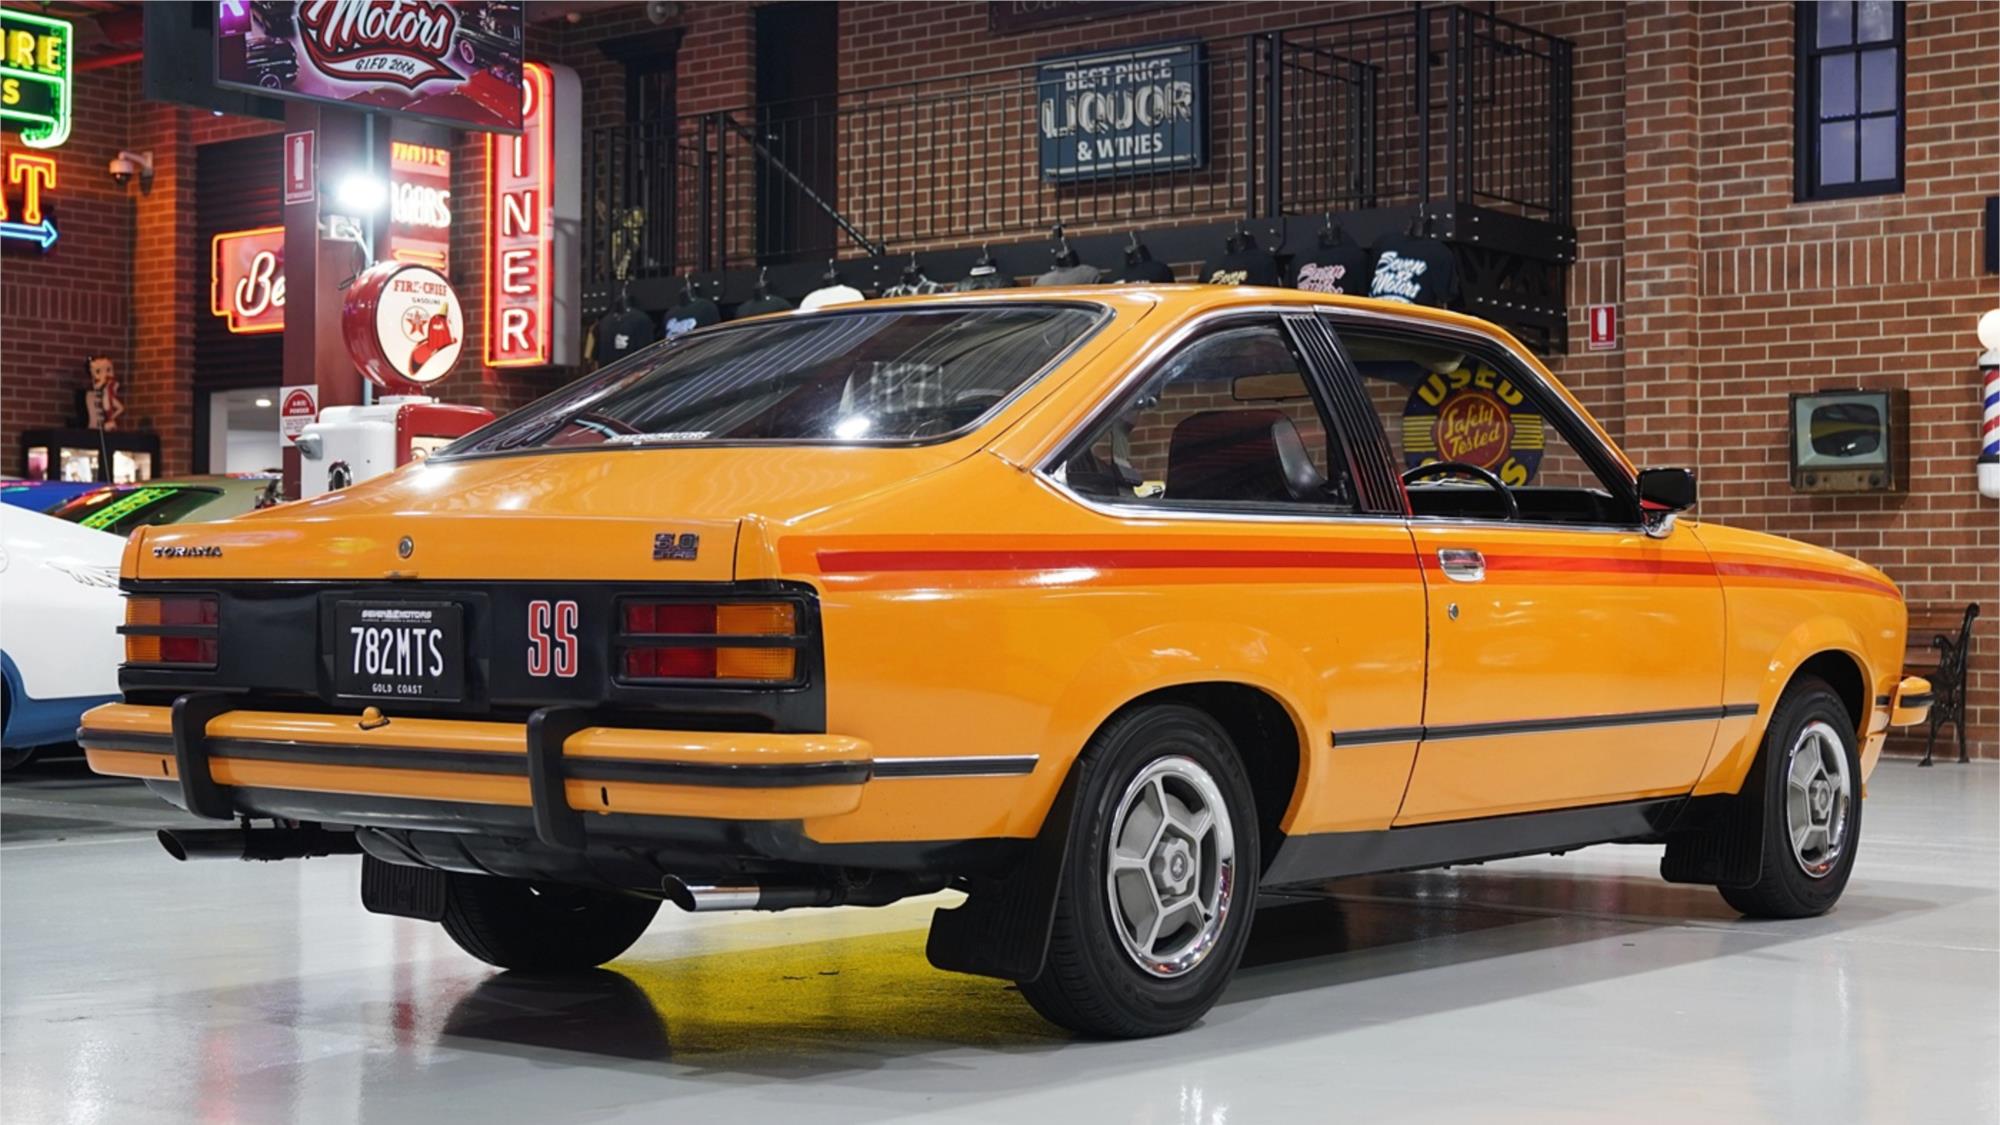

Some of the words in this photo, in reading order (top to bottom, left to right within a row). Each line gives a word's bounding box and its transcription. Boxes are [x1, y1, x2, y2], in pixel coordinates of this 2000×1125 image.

[308, 0, 449, 49] Motors
[0, 28, 62, 73] RE
[1065, 67, 1111, 91] BEST
[1115, 59, 1171, 84] PRICE
[1041, 81, 1193, 138] LIQUOR
[1077, 141, 1093, 161] &
[1096, 133, 1163, 159] WINES
[1417, 363, 1524, 406] USED
[1444, 403, 1494, 439] Safety
[1449, 422, 1501, 457] Tested
[350, 627, 443, 677] 782MTS
[528, 600, 578, 677] SS
[372, 683, 393, 693] GOLD
[397, 684, 423, 694] COAST
